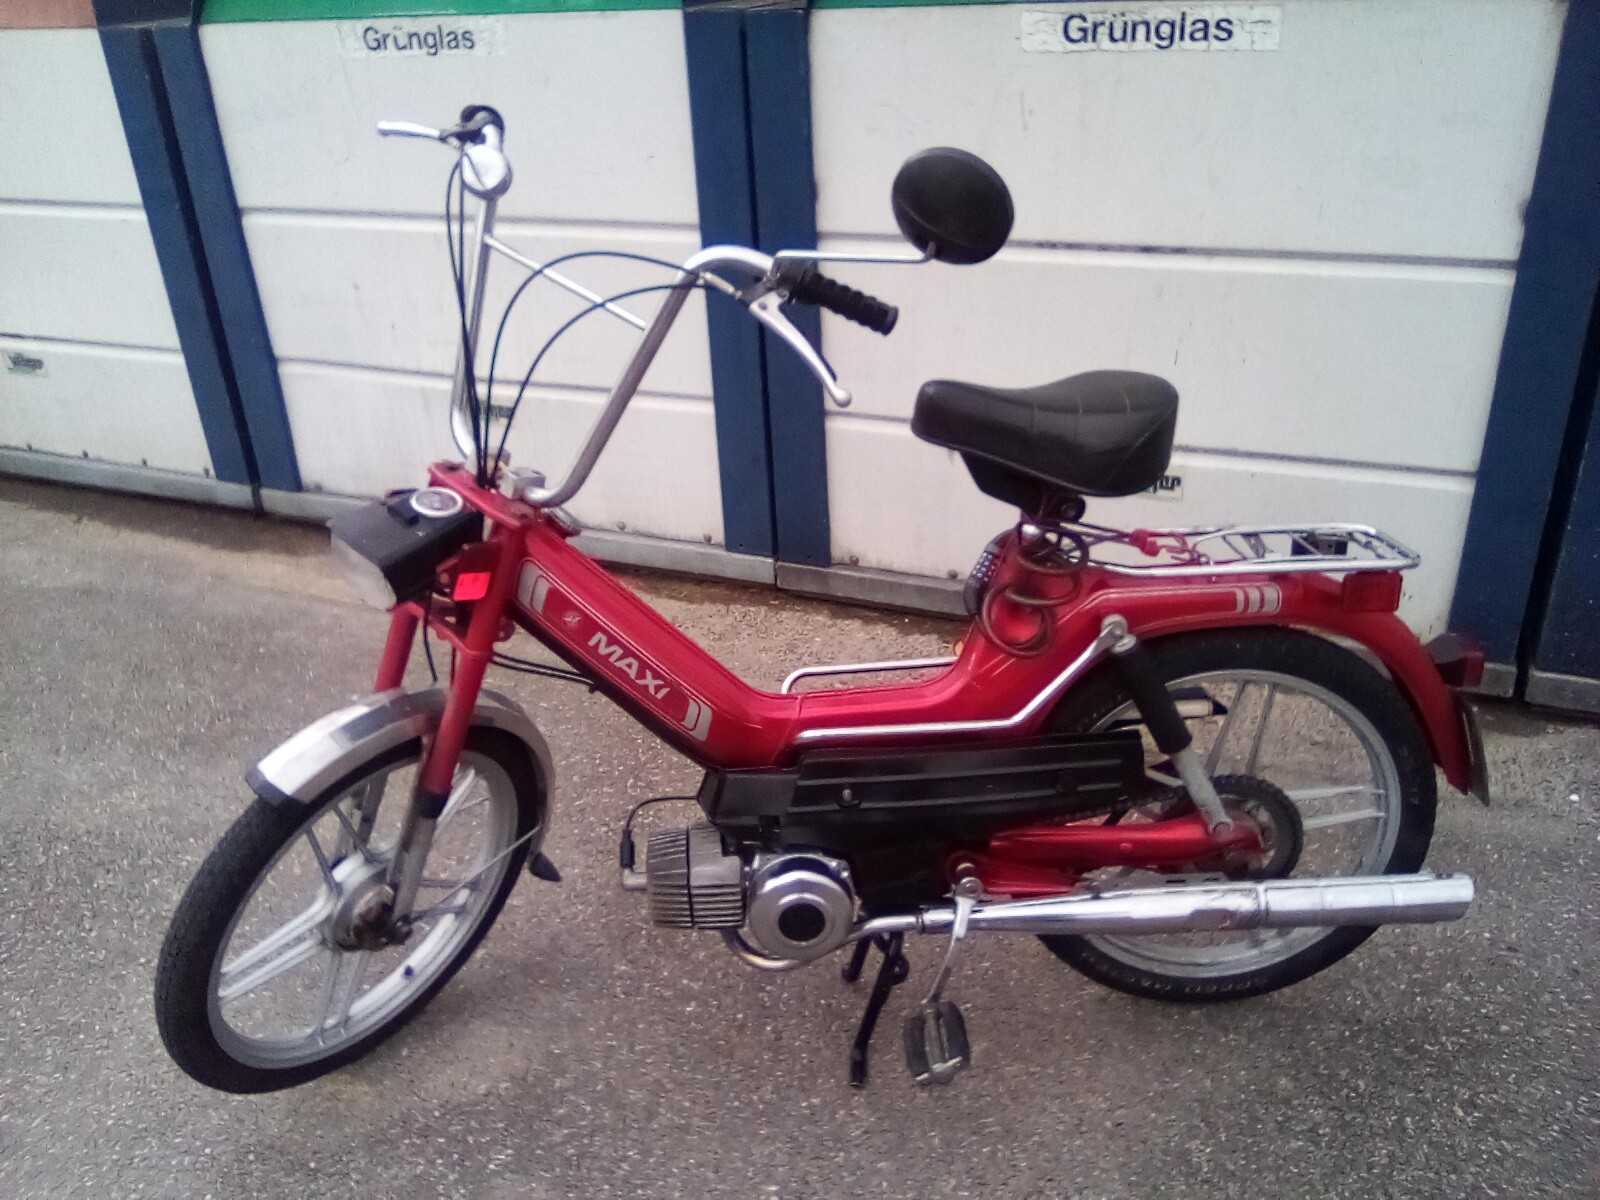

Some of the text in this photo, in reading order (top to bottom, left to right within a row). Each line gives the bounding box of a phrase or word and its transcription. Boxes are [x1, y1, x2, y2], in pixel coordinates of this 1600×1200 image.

[363, 24, 476, 56] Grünglas
[1062, 11, 1234, 50] Grünglas
[587, 631, 671, 700] MAXI
